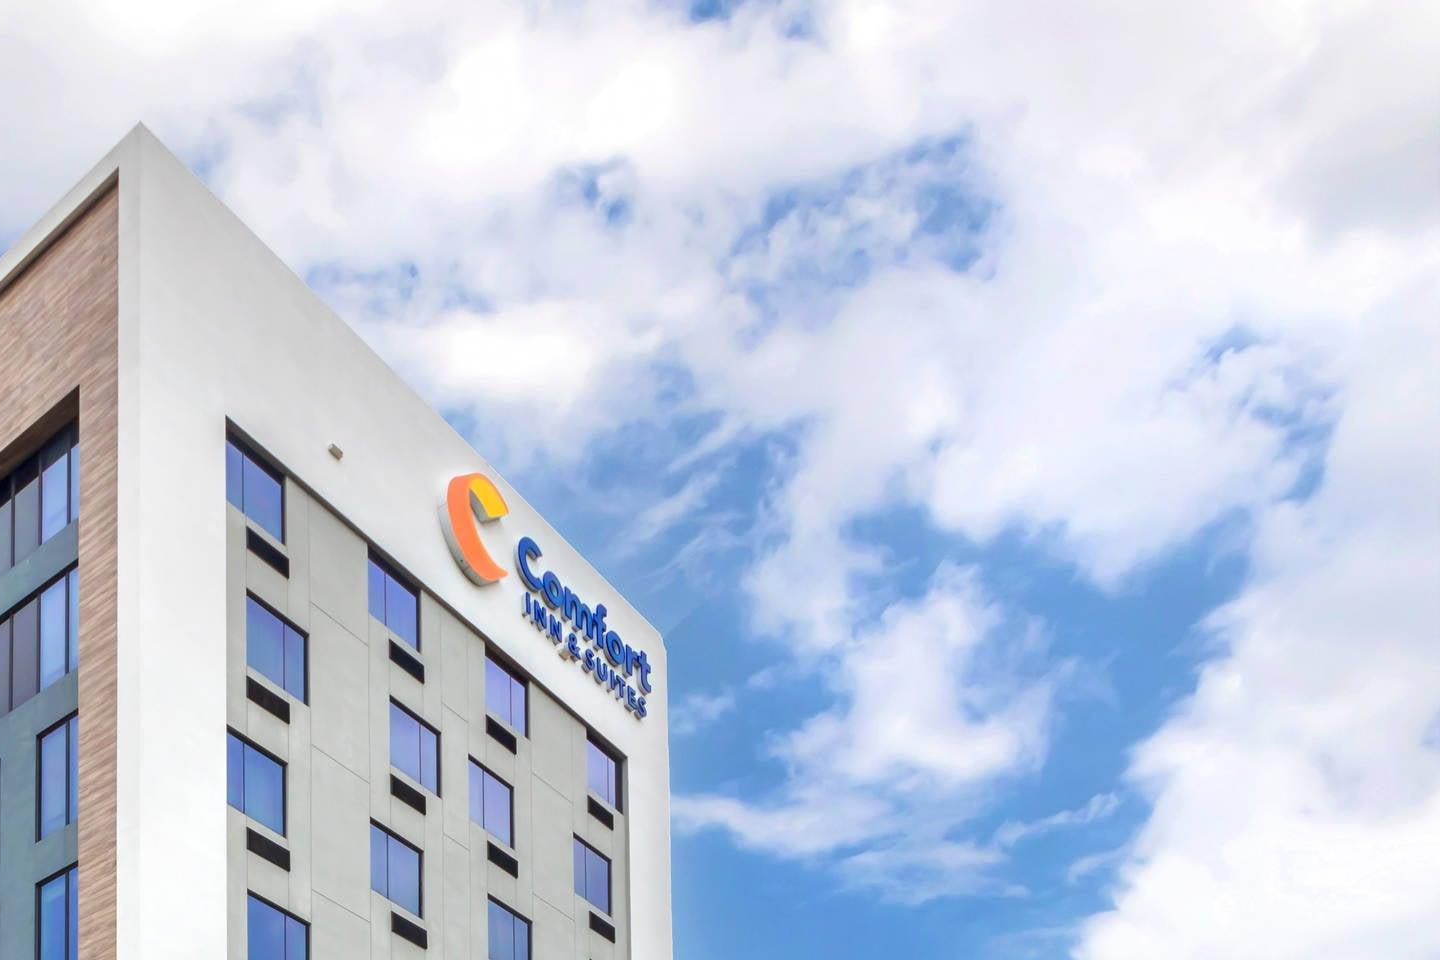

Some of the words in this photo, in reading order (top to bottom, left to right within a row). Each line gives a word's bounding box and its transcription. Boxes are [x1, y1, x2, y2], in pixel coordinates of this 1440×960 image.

[515, 536, 652, 695] Comfort
[522, 591, 562, 645] INN
[561, 632, 581, 661] &
[582, 650, 647, 720] SUITES
